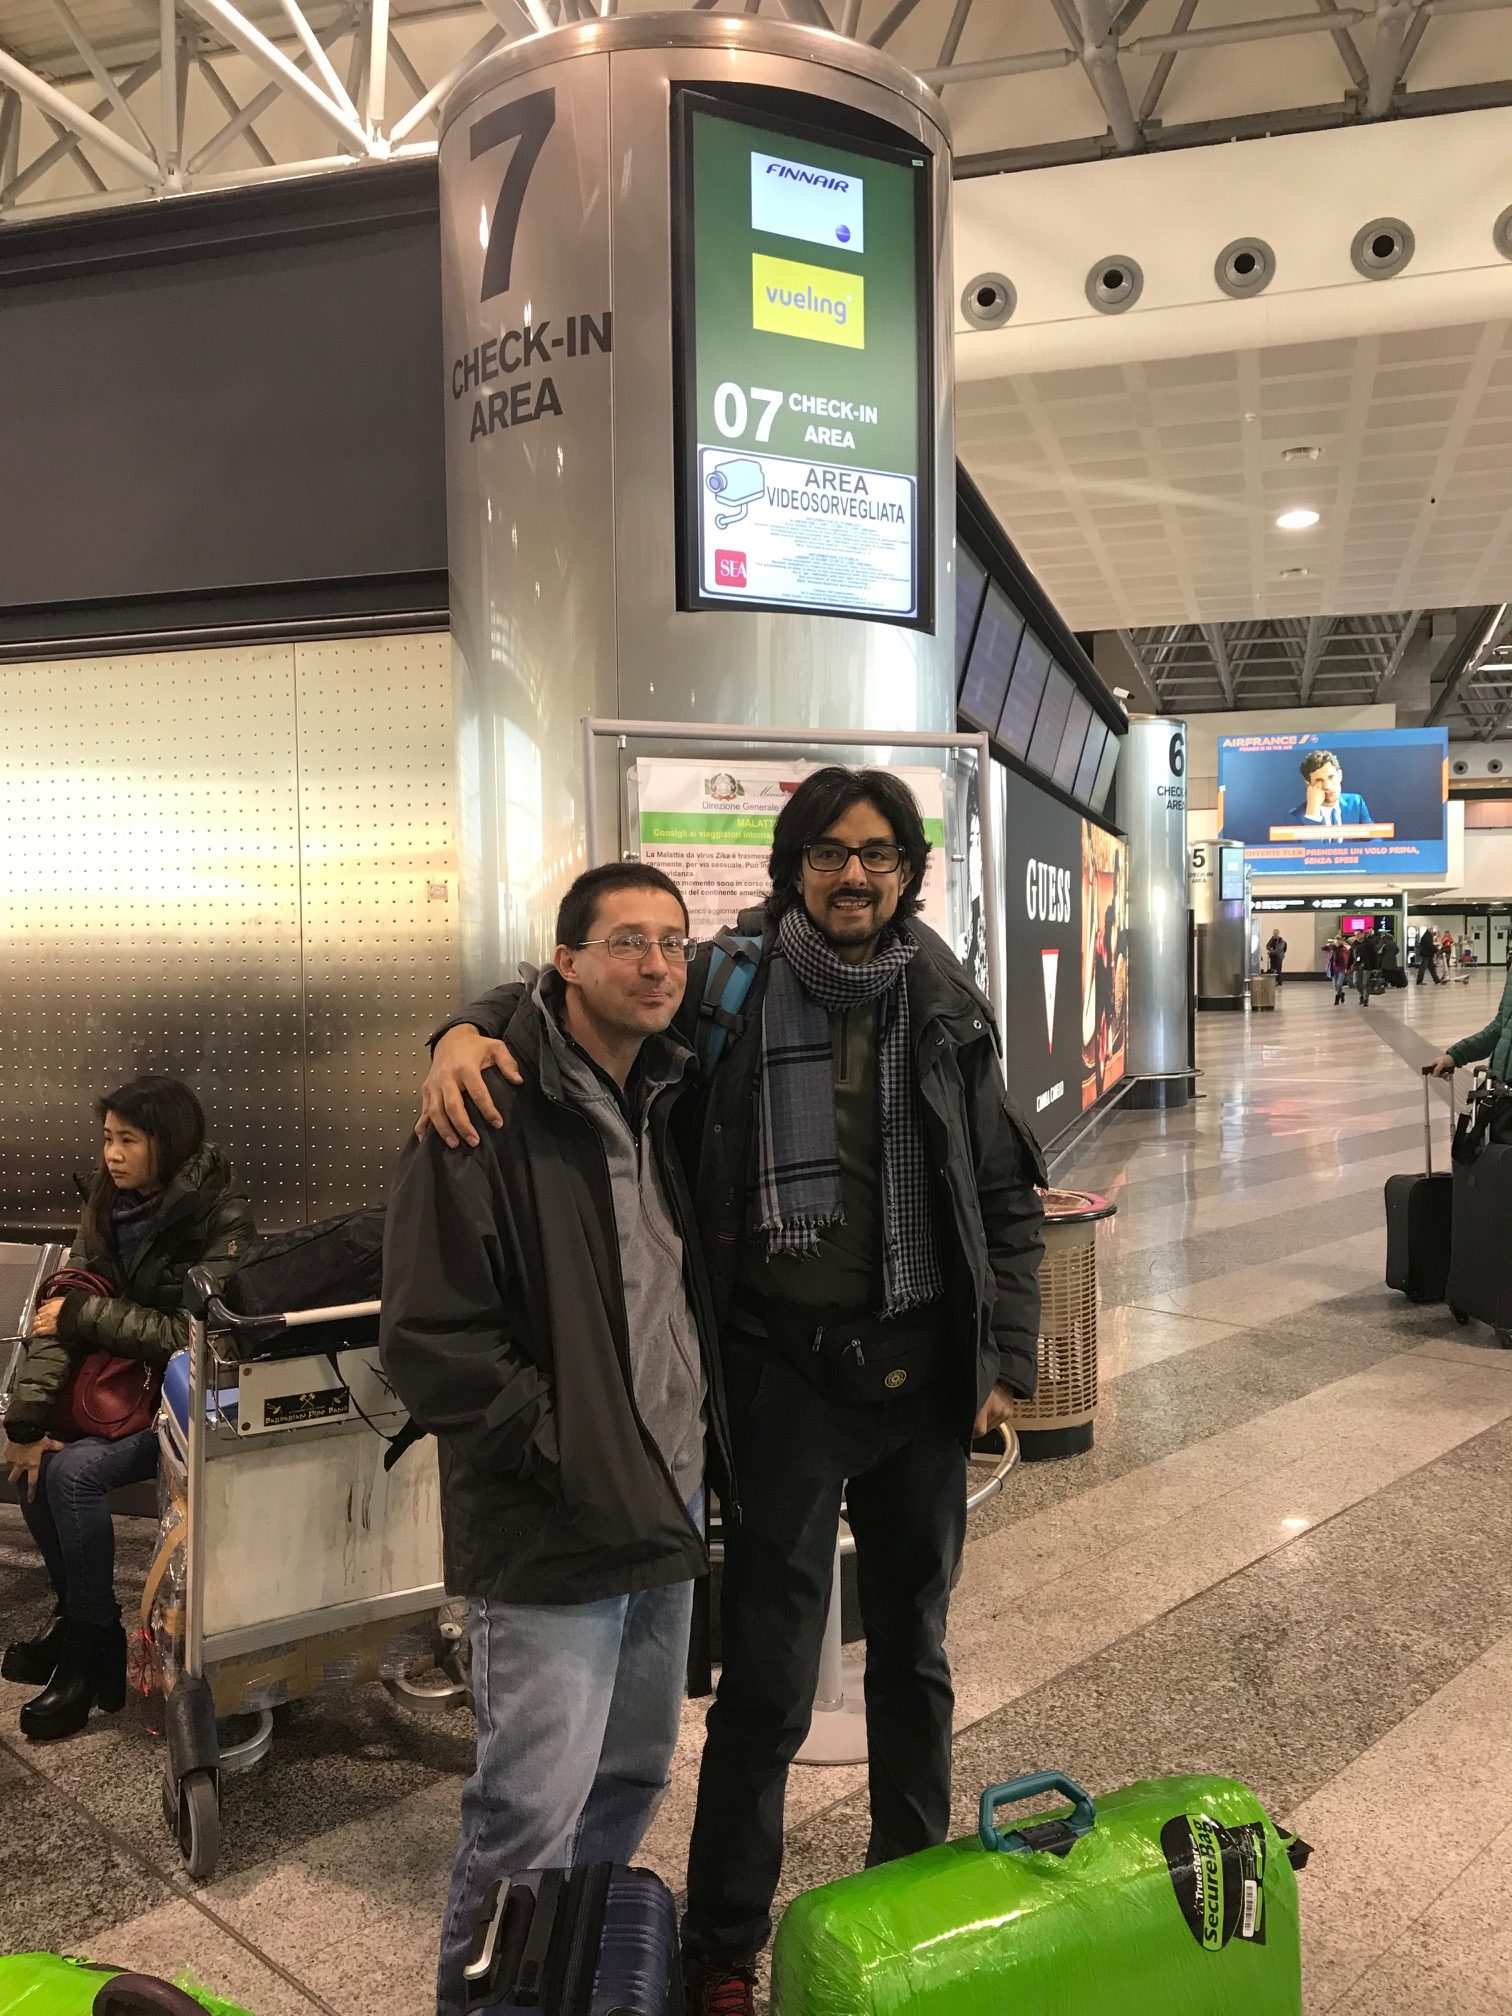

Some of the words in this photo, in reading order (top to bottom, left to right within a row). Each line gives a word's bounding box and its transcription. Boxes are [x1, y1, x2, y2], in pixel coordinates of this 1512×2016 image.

[470, 87, 556, 303] 7
[766, 163, 849, 193] FINNAIR
[766, 285, 847, 325] vueling
[452, 311, 612, 400] CHECK-IN
[469, 377, 563, 442] AREA
[713, 381, 784, 443] 07
[788, 392, 878, 424] CHECK-IN
[804, 425, 856, 449] AREA
[804, 467, 869, 496] AREA
[767, 486, 905, 524] VIDEOSORVEGLIATA
[720, 558, 747, 579] SEA
[1169, 732, 1184, 777] 6
[1223, 736, 1297, 747] AIRFRANCE
[702, 801, 741, 811] Direzione
[743, 802, 780, 811] Generale
[653, 828, 688, 839] Consigli
[689, 829, 697, 837] ai
[699, 830, 741, 840] viaggiatori
[736, 819, 776, 828] MALATT
[1192, 848, 1206, 867] 5
[1026, 858, 1070, 923] GUESS
[1193, 1819, 1218, 1943] SecureBag
